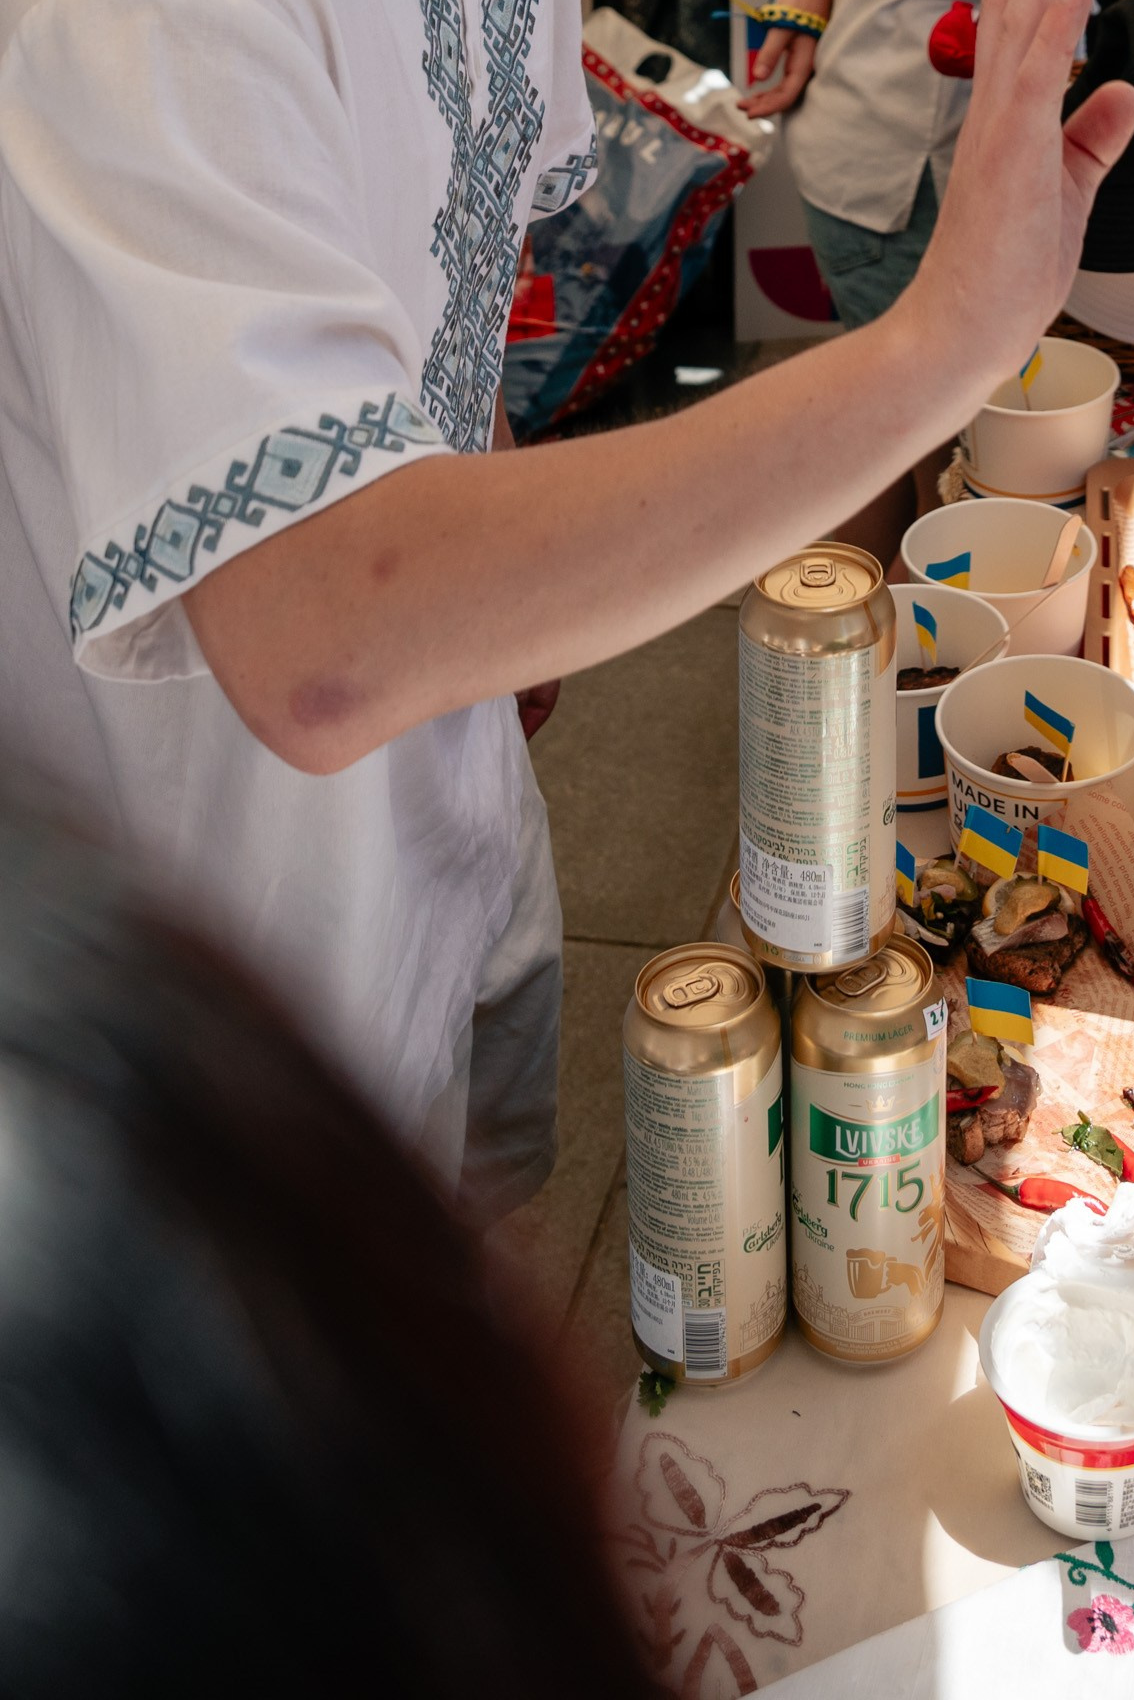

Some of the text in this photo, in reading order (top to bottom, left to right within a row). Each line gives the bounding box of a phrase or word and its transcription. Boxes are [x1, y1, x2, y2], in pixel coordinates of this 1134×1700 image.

[952, 770, 1006, 816] MADE
[1014, 803, 1039, 821] IN
[1078, 819, 1095, 843] eating
[1094, 842, 1109, 866] habits
[1107, 866, 1116, 878] for
[1113, 879, 1127, 902] bread
[800, 870, 826, 883] 480ml
[1105, 890, 1117, 907] food
[843, 1024, 914, 1043] PREMIUM LAGER
[843, 1081, 866, 1089] HONG
[834, 1117, 924, 1159] LVIVSKE
[862, 1157, 897, 1166] UKRAINE
[826, 1159, 925, 1223] 1715
[743, 1211, 782, 1254] Carlsberg
[804, 1228, 836, 1252] Ukraine
[652, 1273, 676, 1293] 480ml
